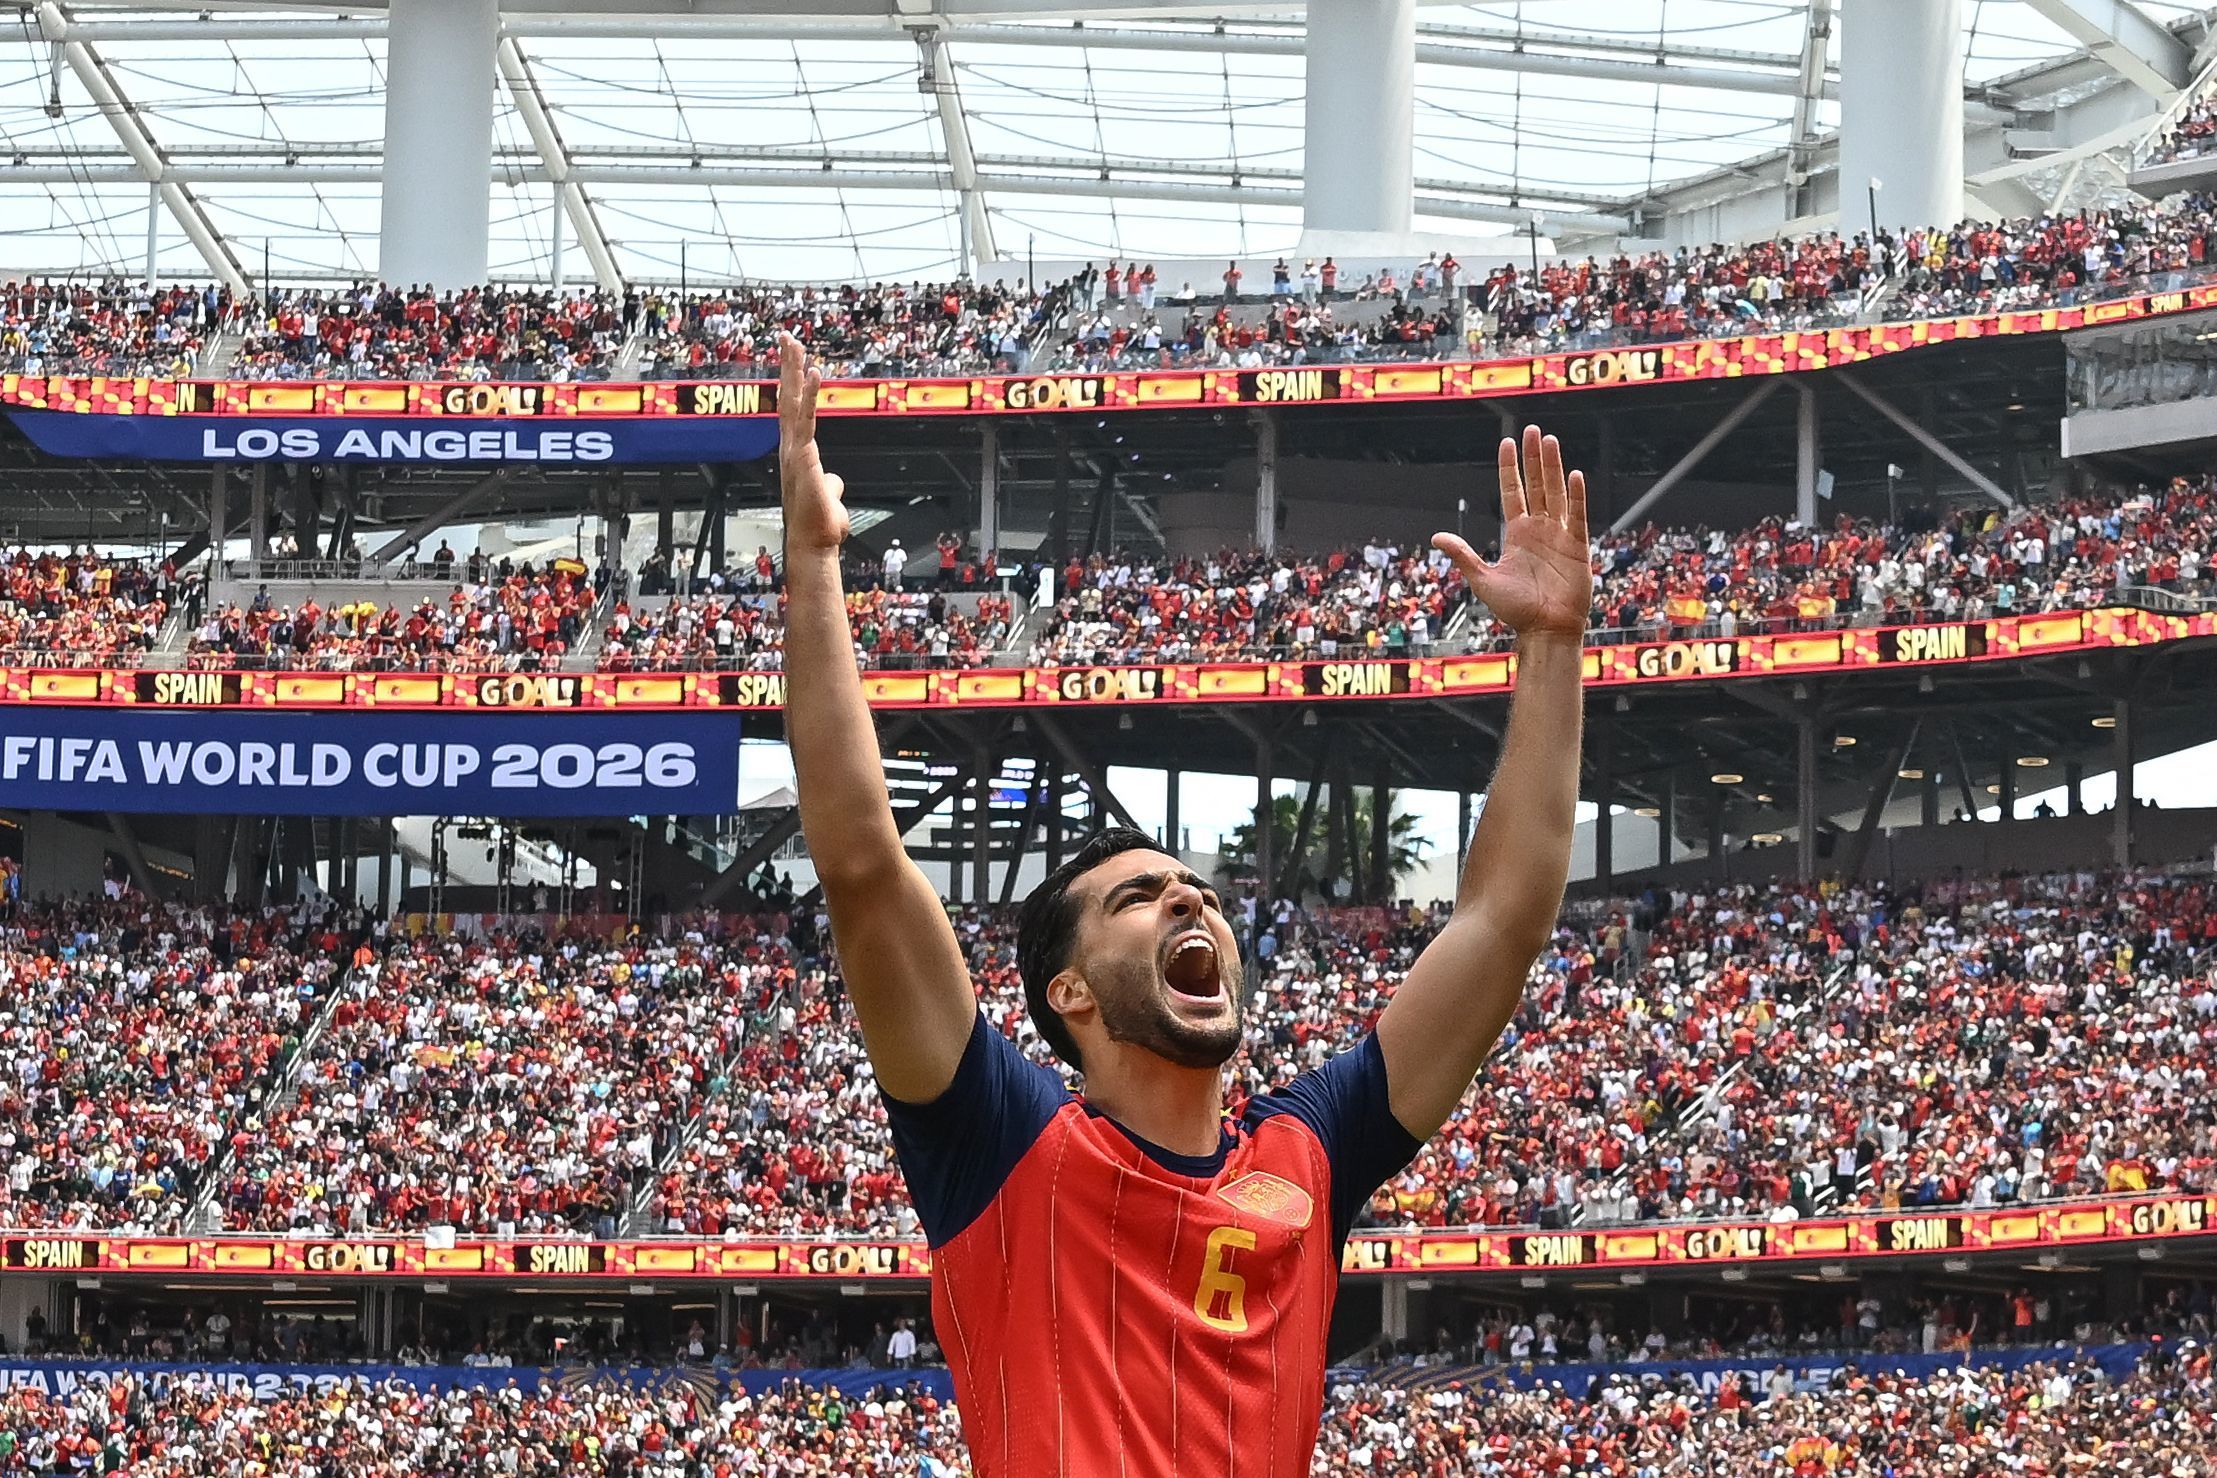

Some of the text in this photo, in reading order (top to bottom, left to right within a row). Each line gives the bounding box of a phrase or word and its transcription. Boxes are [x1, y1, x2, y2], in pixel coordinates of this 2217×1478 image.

[2151, 294, 2183, 313] SPAIN
[1569, 351, 1656, 385] GOAL!
[446, 384, 536, 415] GOAL!
[694, 384, 759, 415] SPAIN
[1008, 377, 1098, 408] GOAL!
[1256, 370, 1322, 402] SPAIN
[203, 429, 614, 460] LOS ANGELES
[1640, 642, 1732, 678] GOAL!
[1896, 626, 1966, 662] SPAIN
[154, 673, 222, 704] SPAIN
[481, 673, 574, 707] GOAL!
[1063, 669, 1156, 702] GOAL!
[1321, 664, 1391, 696] SPAIN
[3, 736, 697, 788] FIFA WORLD CUP 2026
[2134, 1200, 2203, 1233] GOAL!
[1688, 1226, 1762, 1258] GOAL!
[1891, 1218, 1948, 1250] SPAIN
[24, 1240, 83, 1268] SPAIN
[308, 1243, 389, 1272] GOAL!
[530, 1245, 589, 1274] SPAIN
[812, 1245, 893, 1275] GOAL!
[1524, 1236, 1583, 1266] SPAIN
[1194, 1226, 1257, 1332] 6
